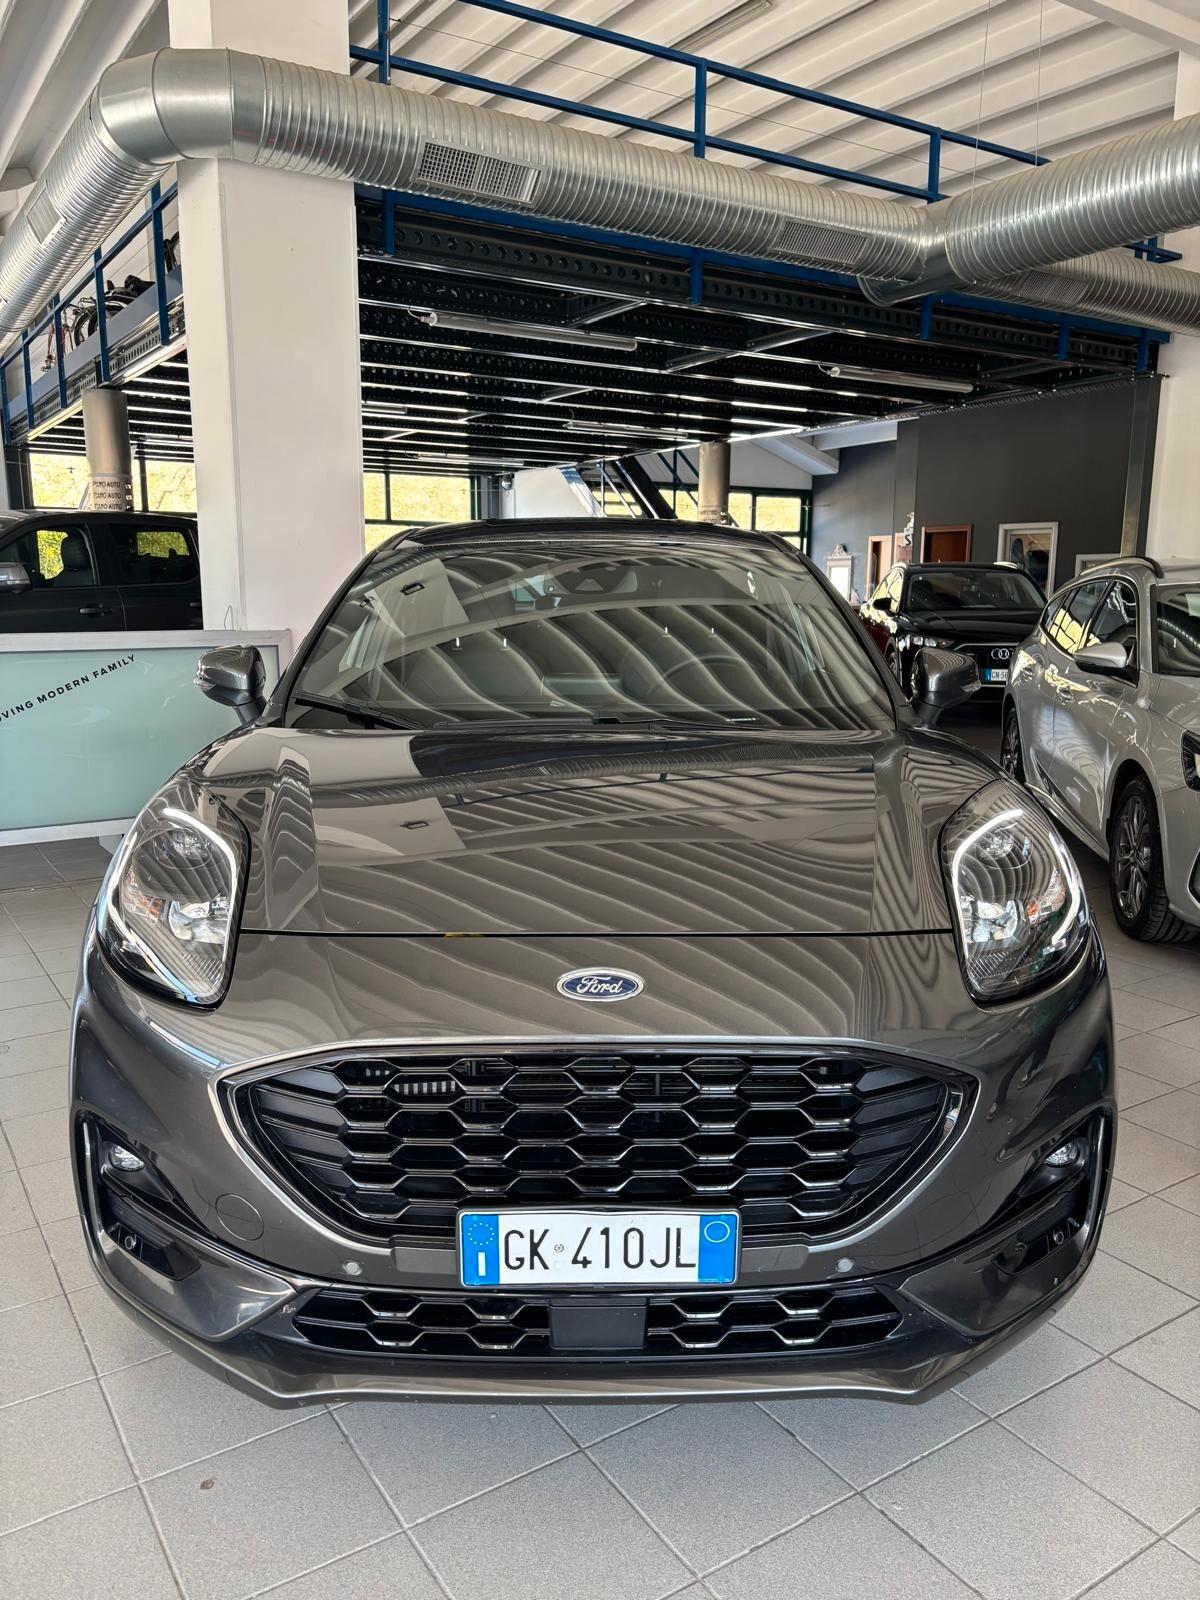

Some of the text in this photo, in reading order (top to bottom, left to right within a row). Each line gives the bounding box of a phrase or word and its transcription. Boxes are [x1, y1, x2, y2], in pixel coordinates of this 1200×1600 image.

[0, 654, 135, 722] VING MODERN FAMILY
[576, 976, 623, 994] Ford
[504, 1227, 696, 1270] GK 410JL
